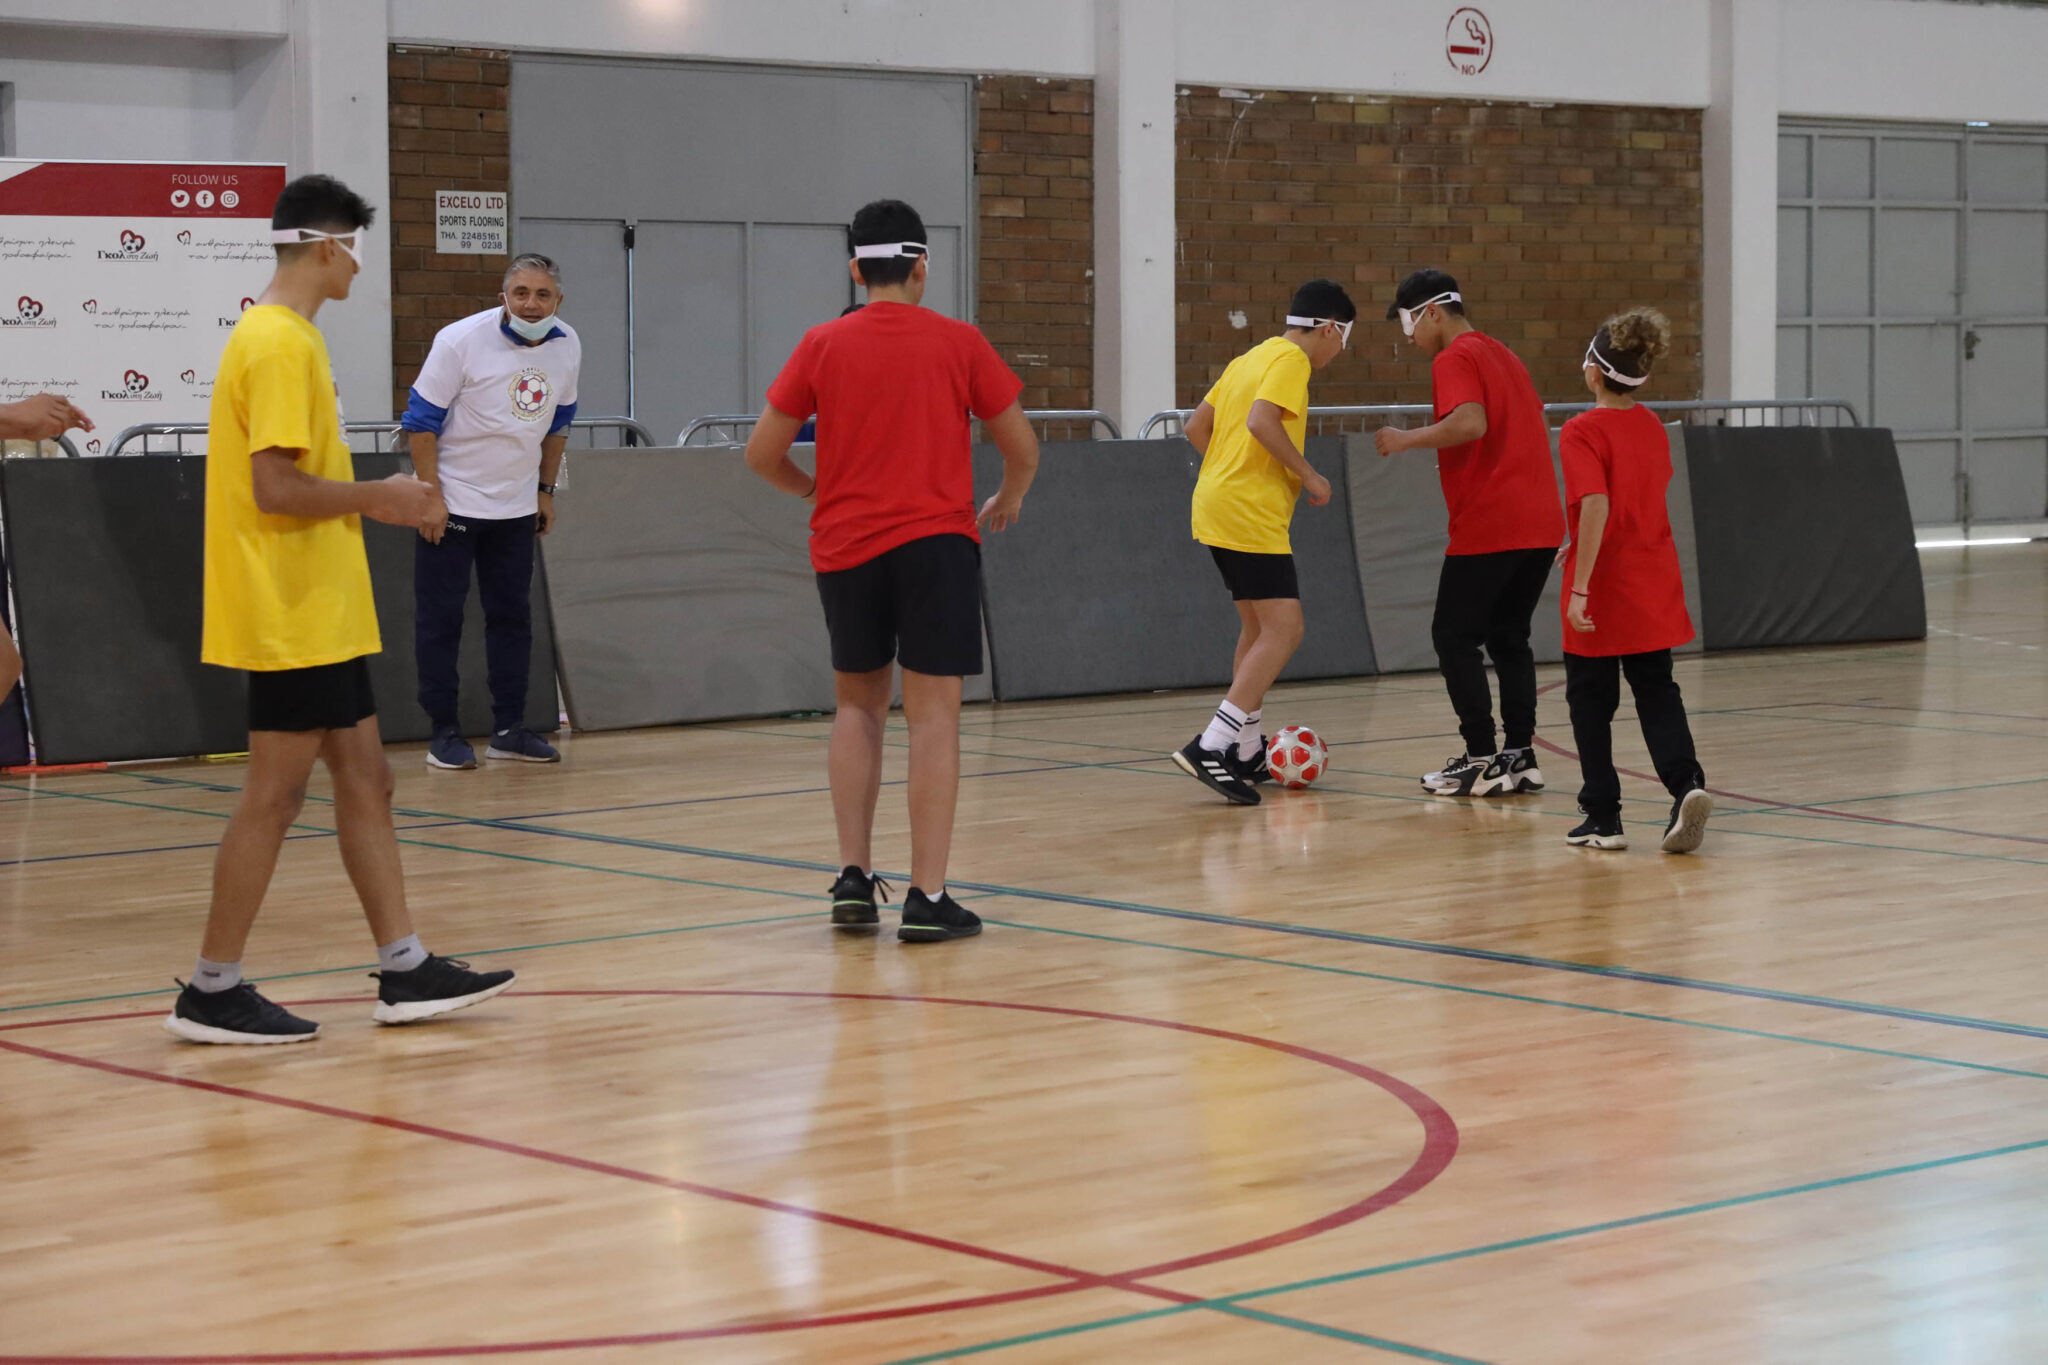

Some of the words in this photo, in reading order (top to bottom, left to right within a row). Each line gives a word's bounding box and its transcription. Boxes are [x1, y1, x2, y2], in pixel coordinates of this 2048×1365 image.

[1461, 64, 1476, 76] NO
[171, 174, 219, 185] FOLLOW
[222, 174, 239, 185] US
[439, 196, 481, 209] EXCELO
[486, 196, 504, 209] LTD
[439, 215, 467, 226] SPORTS
[469, 216, 504, 227] FLOORING
[461, 232, 500, 240] 22485161
[461, 241, 471, 249] 99
[97, 250, 125, 260] Γκολ
[140, 250, 159, 262] Ζωή
[0, 316, 23, 326] κολ
[101, 390, 129, 399] Γκολ
